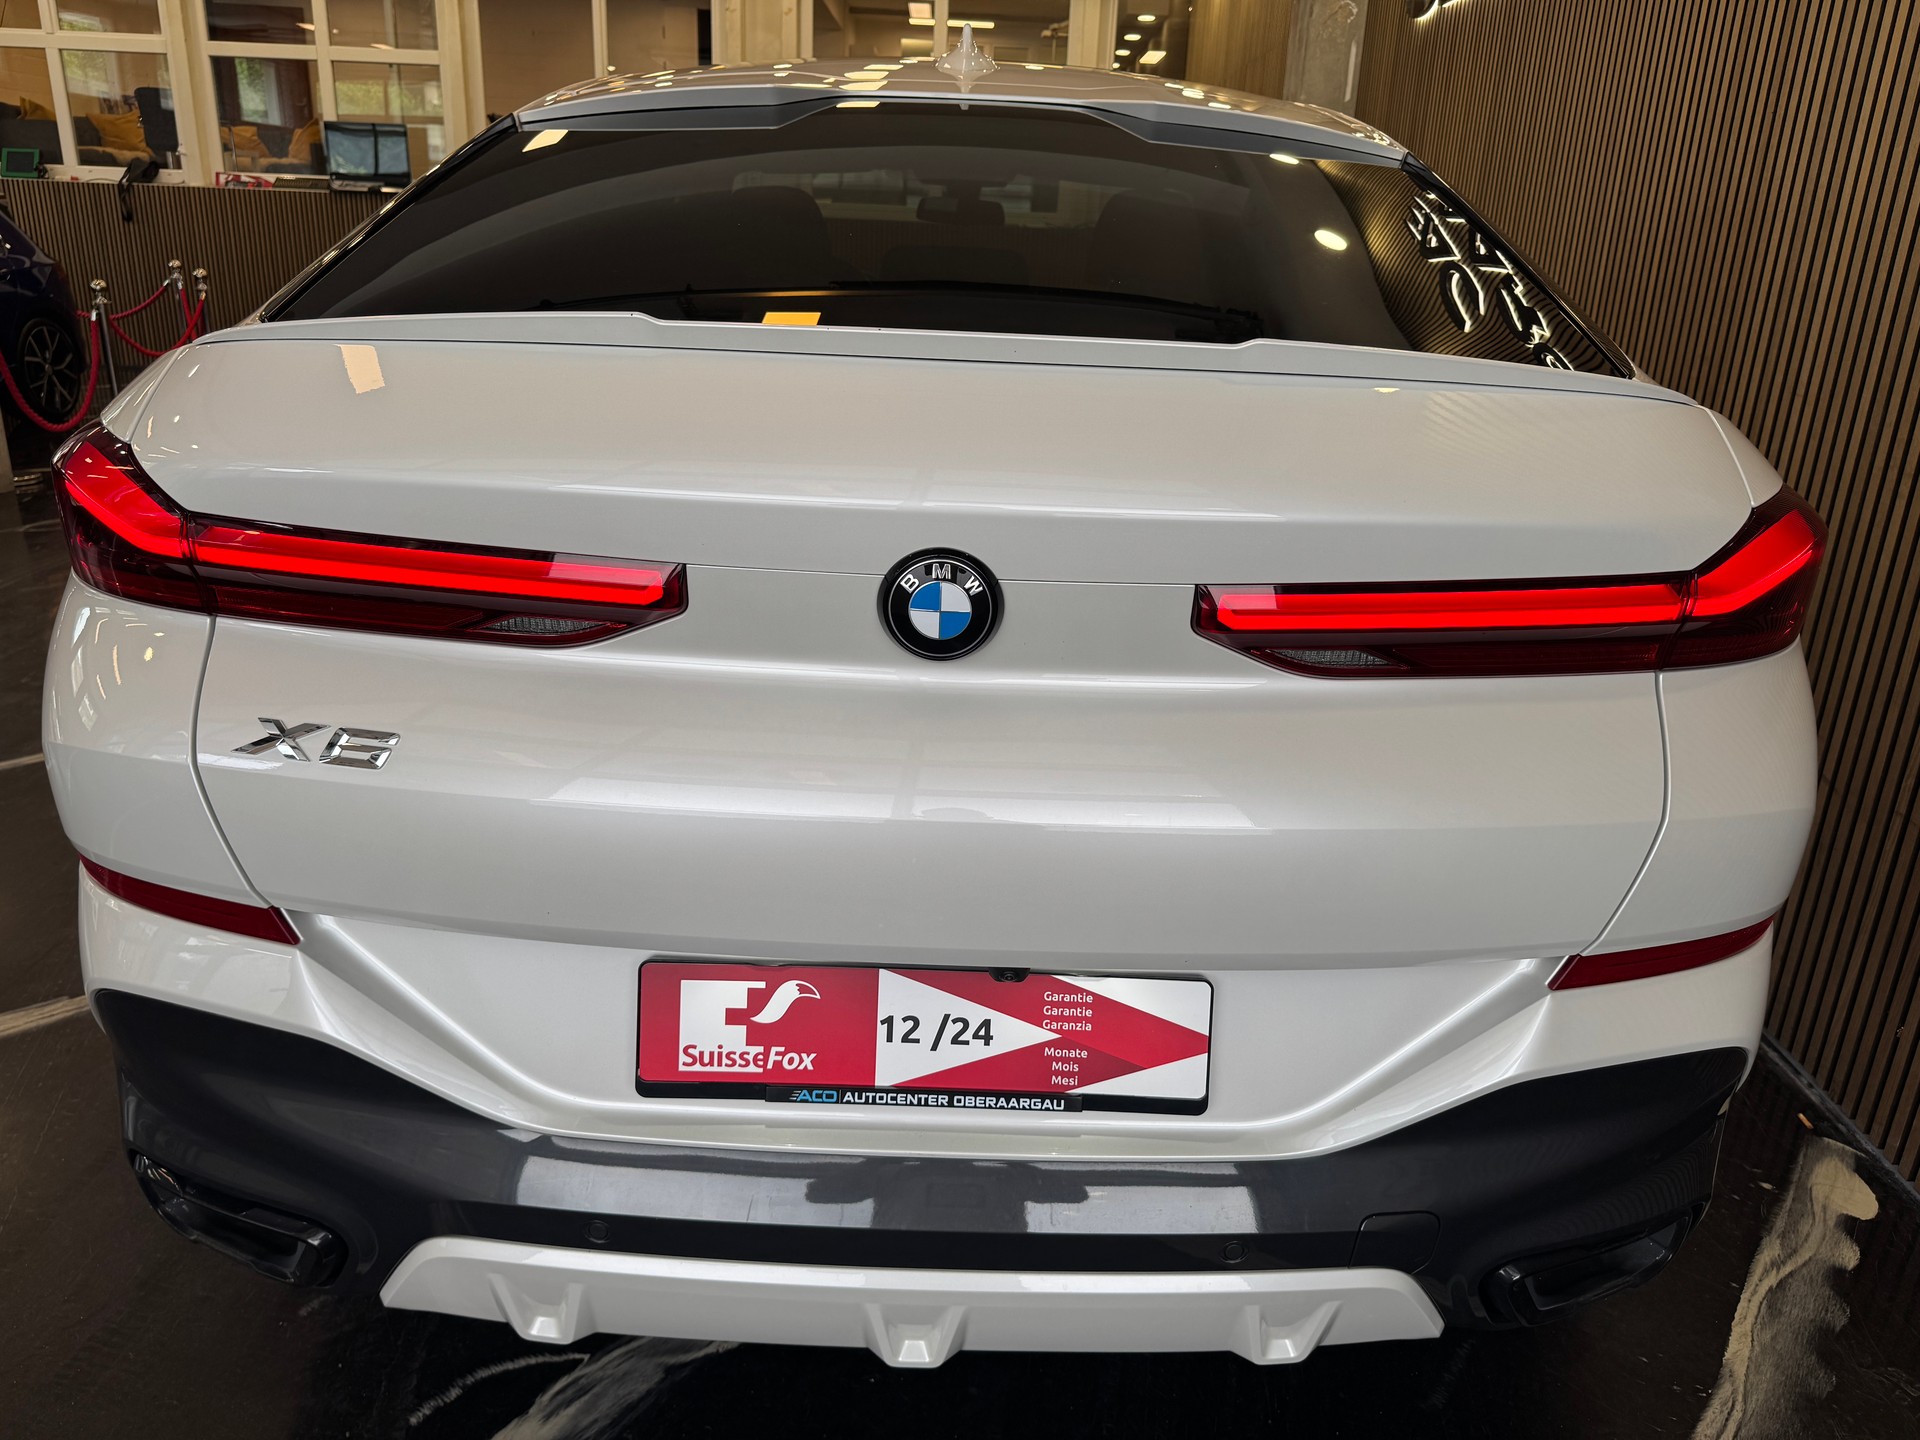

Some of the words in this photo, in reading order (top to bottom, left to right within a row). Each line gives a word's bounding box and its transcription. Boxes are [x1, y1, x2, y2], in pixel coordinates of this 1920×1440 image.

[900, 563, 984, 597] BMW
[230, 717, 401, 770] X6
[1043, 991, 1094, 1004] Garantie
[1043, 1005, 1093, 1017] Garantie
[880, 1015, 921, 1044] 12
[1042, 1019, 1092, 1032] Garanzia
[1044, 1046, 1088, 1059] Monate
[1051, 1061, 1079, 1072] Mois
[1051, 1075, 1078, 1086] Mesi
[796, 1089, 838, 1103] ACO
[842, 1091, 949, 1106] AUTOCENTER
[953, 1095, 1065, 1110] OBERAARGAU
